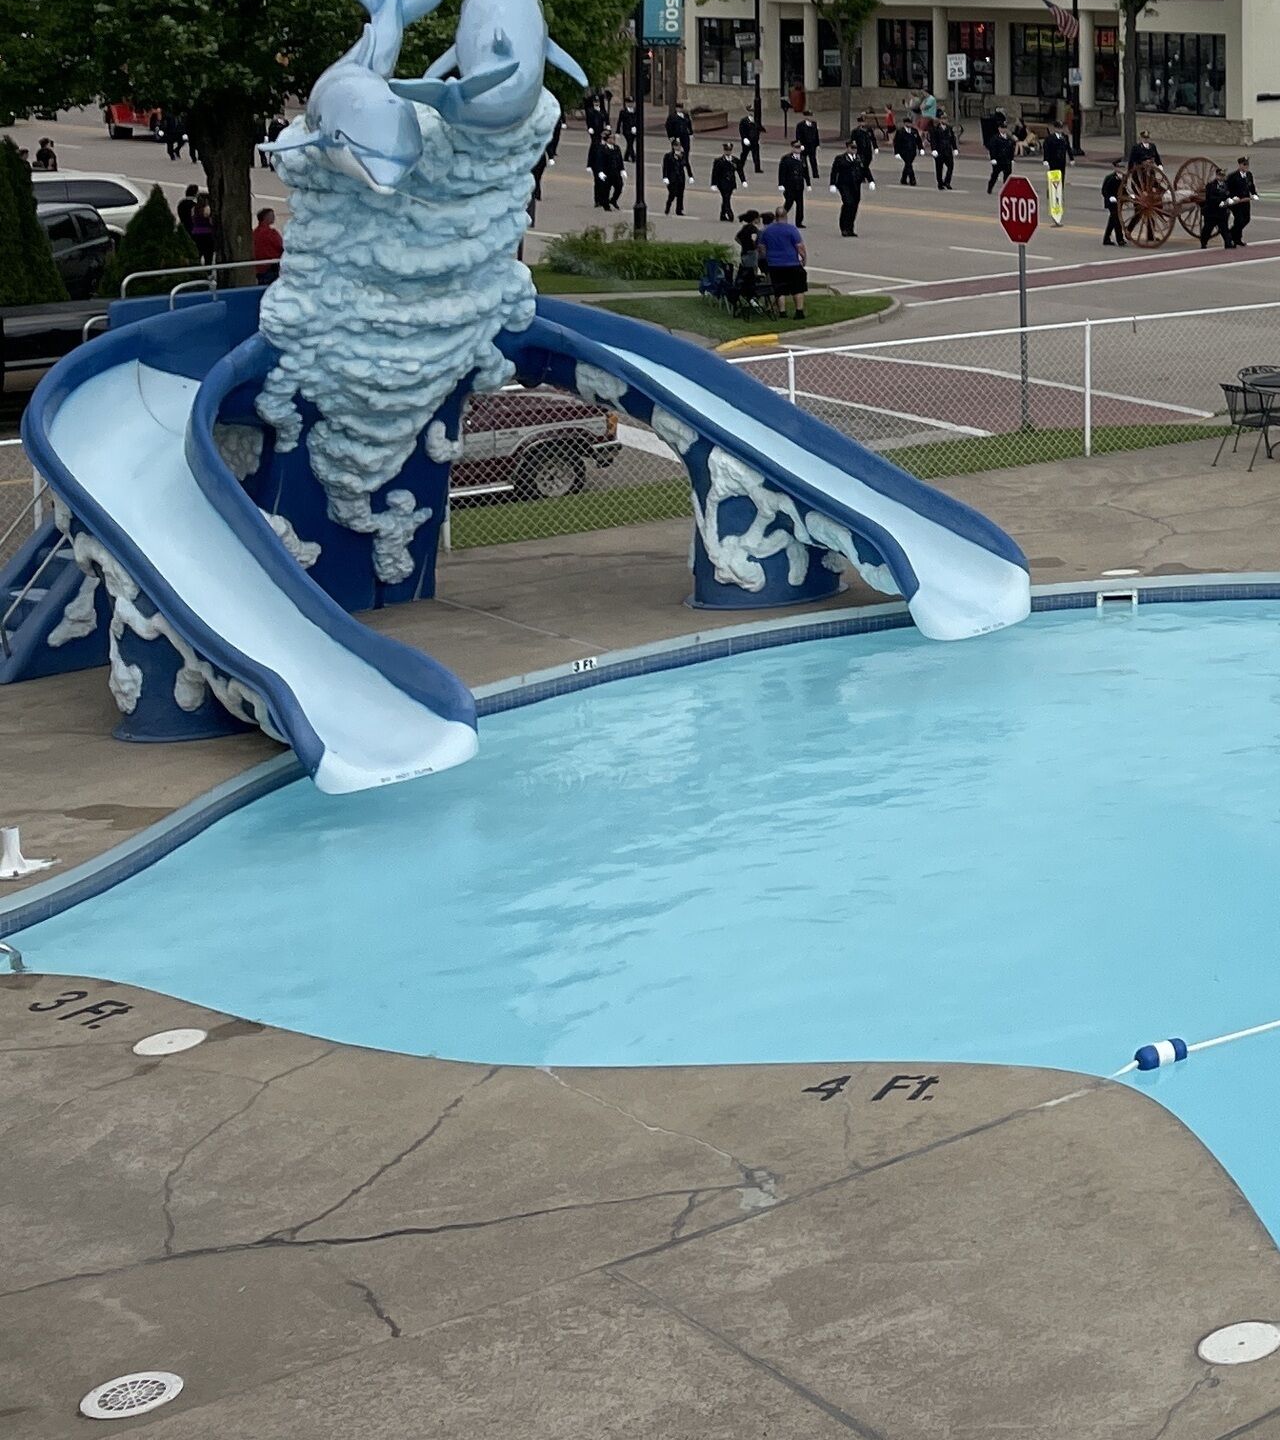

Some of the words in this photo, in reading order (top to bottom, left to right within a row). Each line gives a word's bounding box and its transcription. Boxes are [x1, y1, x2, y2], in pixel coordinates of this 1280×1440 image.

[950, 67, 964, 77] 25
[1001, 196, 1036, 224] STOP
[574, 661, 580, 672] 3
[28, 990, 88, 1011] 3
[57, 1000, 133, 1029] Ft.
[801, 1075, 851, 1101] 4
[871, 1075, 939, 1101] Ft.
